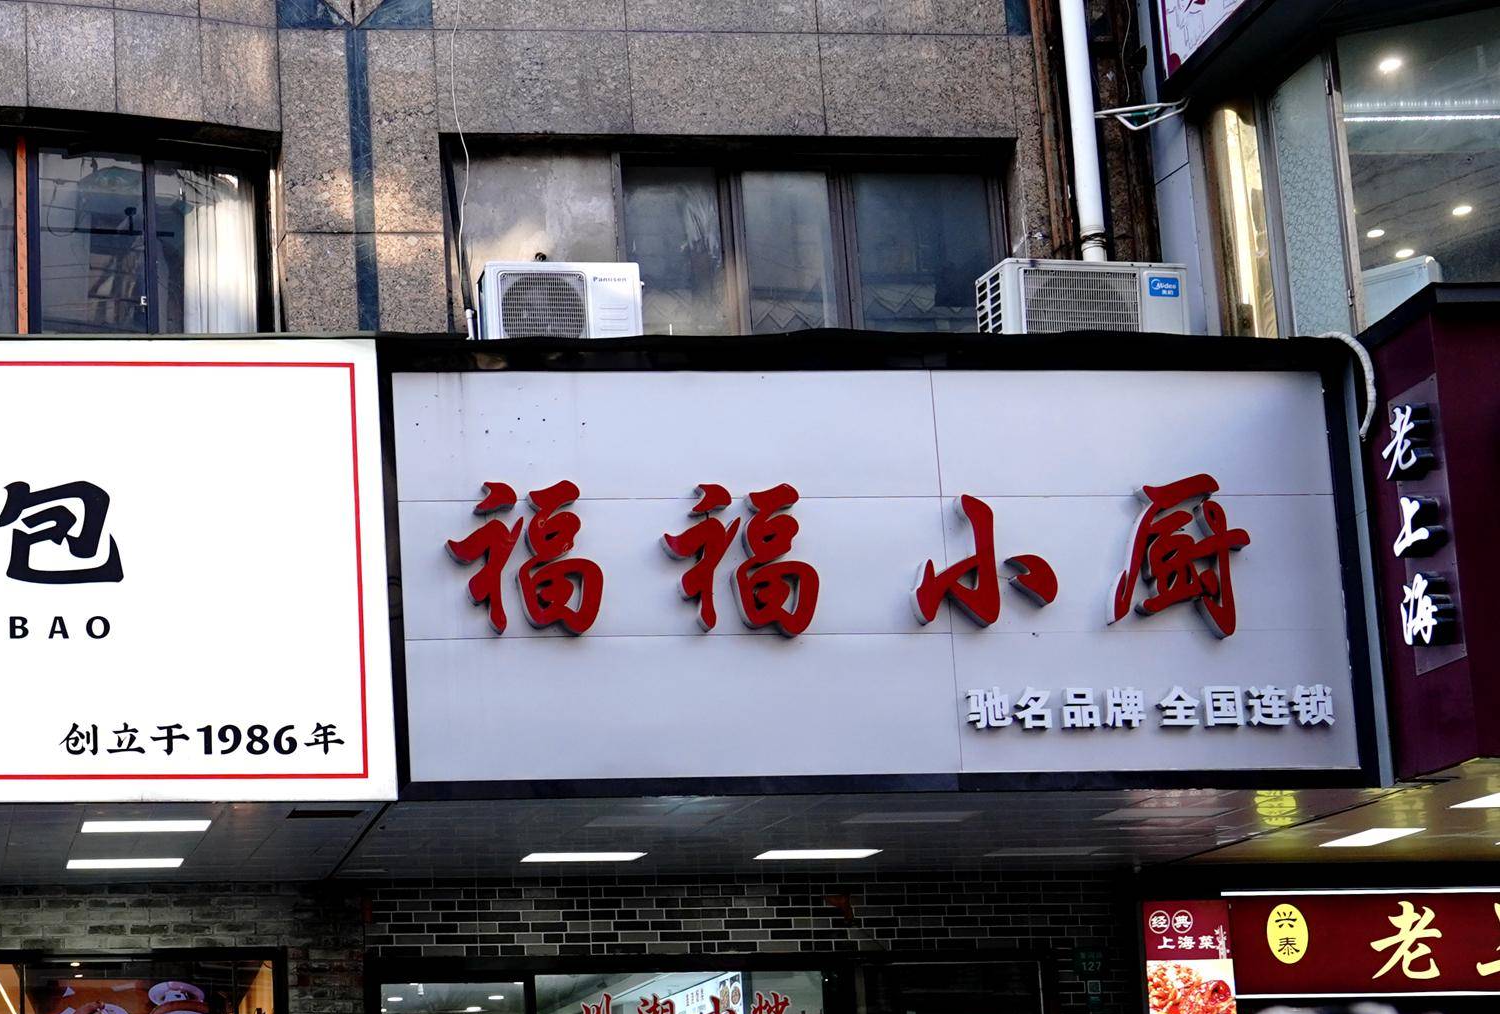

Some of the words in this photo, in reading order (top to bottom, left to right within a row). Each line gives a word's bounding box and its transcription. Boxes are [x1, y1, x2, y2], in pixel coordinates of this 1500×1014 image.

[1381, 405, 1438, 646] 老上海
[445, 473, 1250, 639] 福福小厨
[9, 615, 111, 640] BAO
[966, 685, 1148, 731] 驰名品牌
[1158, 683, 1337, 729] 全国连锁
[59, 722, 345, 758] 创立于1986年
[1150, 914, 1192, 930] 经典
[1157, 935, 1217, 950] 上海菜
[1274, 910, 1301, 956] 兴泰
